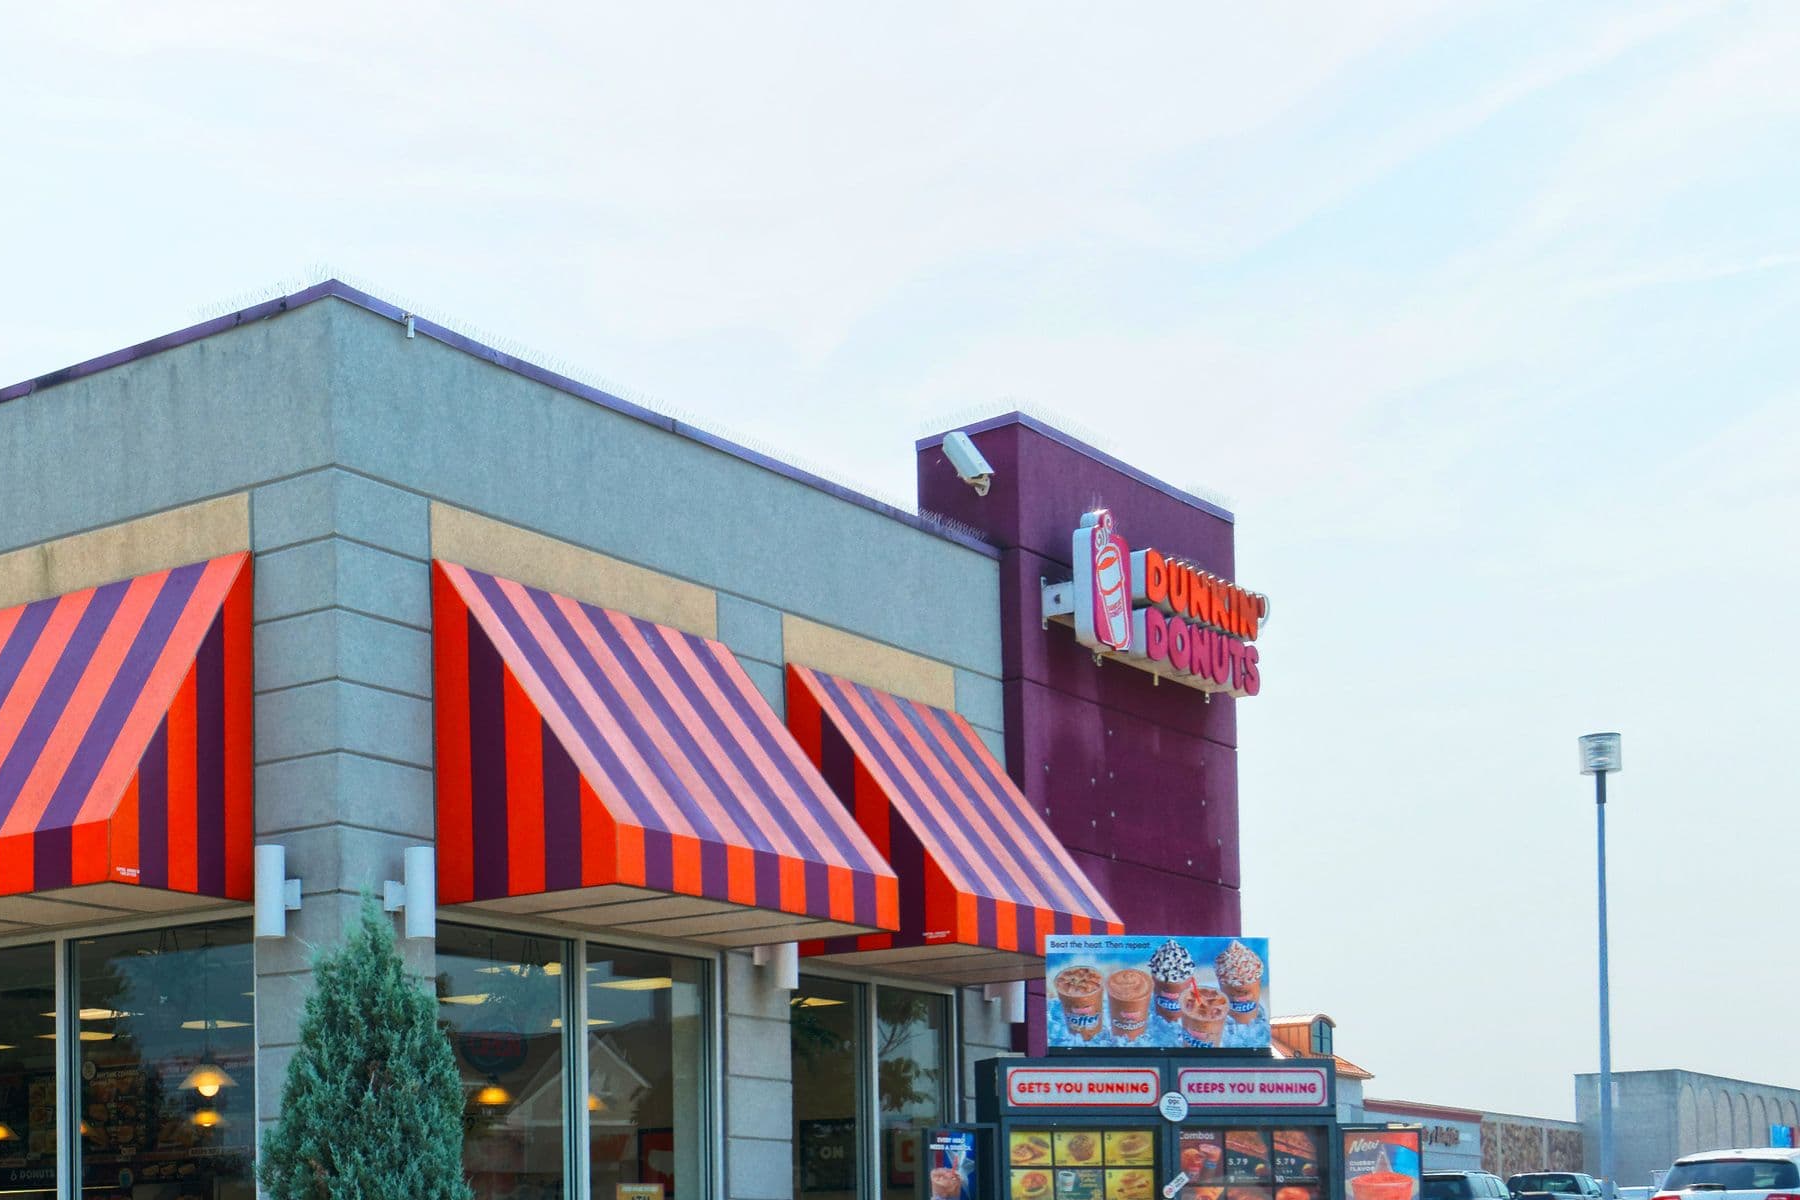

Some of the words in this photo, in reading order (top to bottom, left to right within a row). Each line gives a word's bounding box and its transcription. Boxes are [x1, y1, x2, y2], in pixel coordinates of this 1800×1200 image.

[1146, 549, 1266, 642] DUNKIN'
[1146, 607, 1261, 697] DONUTS
[1050, 941, 1068, 949] Beat
[1069, 941, 1083, 949] the
[1105, 941, 1123, 949] Then
[1017, 1082, 1051, 1094] GETS
[1056, 1082, 1083, 1094] YOU
[1087, 1082, 1149, 1094] RUNNING
[1187, 1082, 1225, 1094] KEEPS
[1229, 1082, 1255, 1094] YOU
[1259, 1082, 1317, 1094] RUNNING
[819, 1145, 844, 1160] ON
[1348, 1138, 1380, 1154] New
